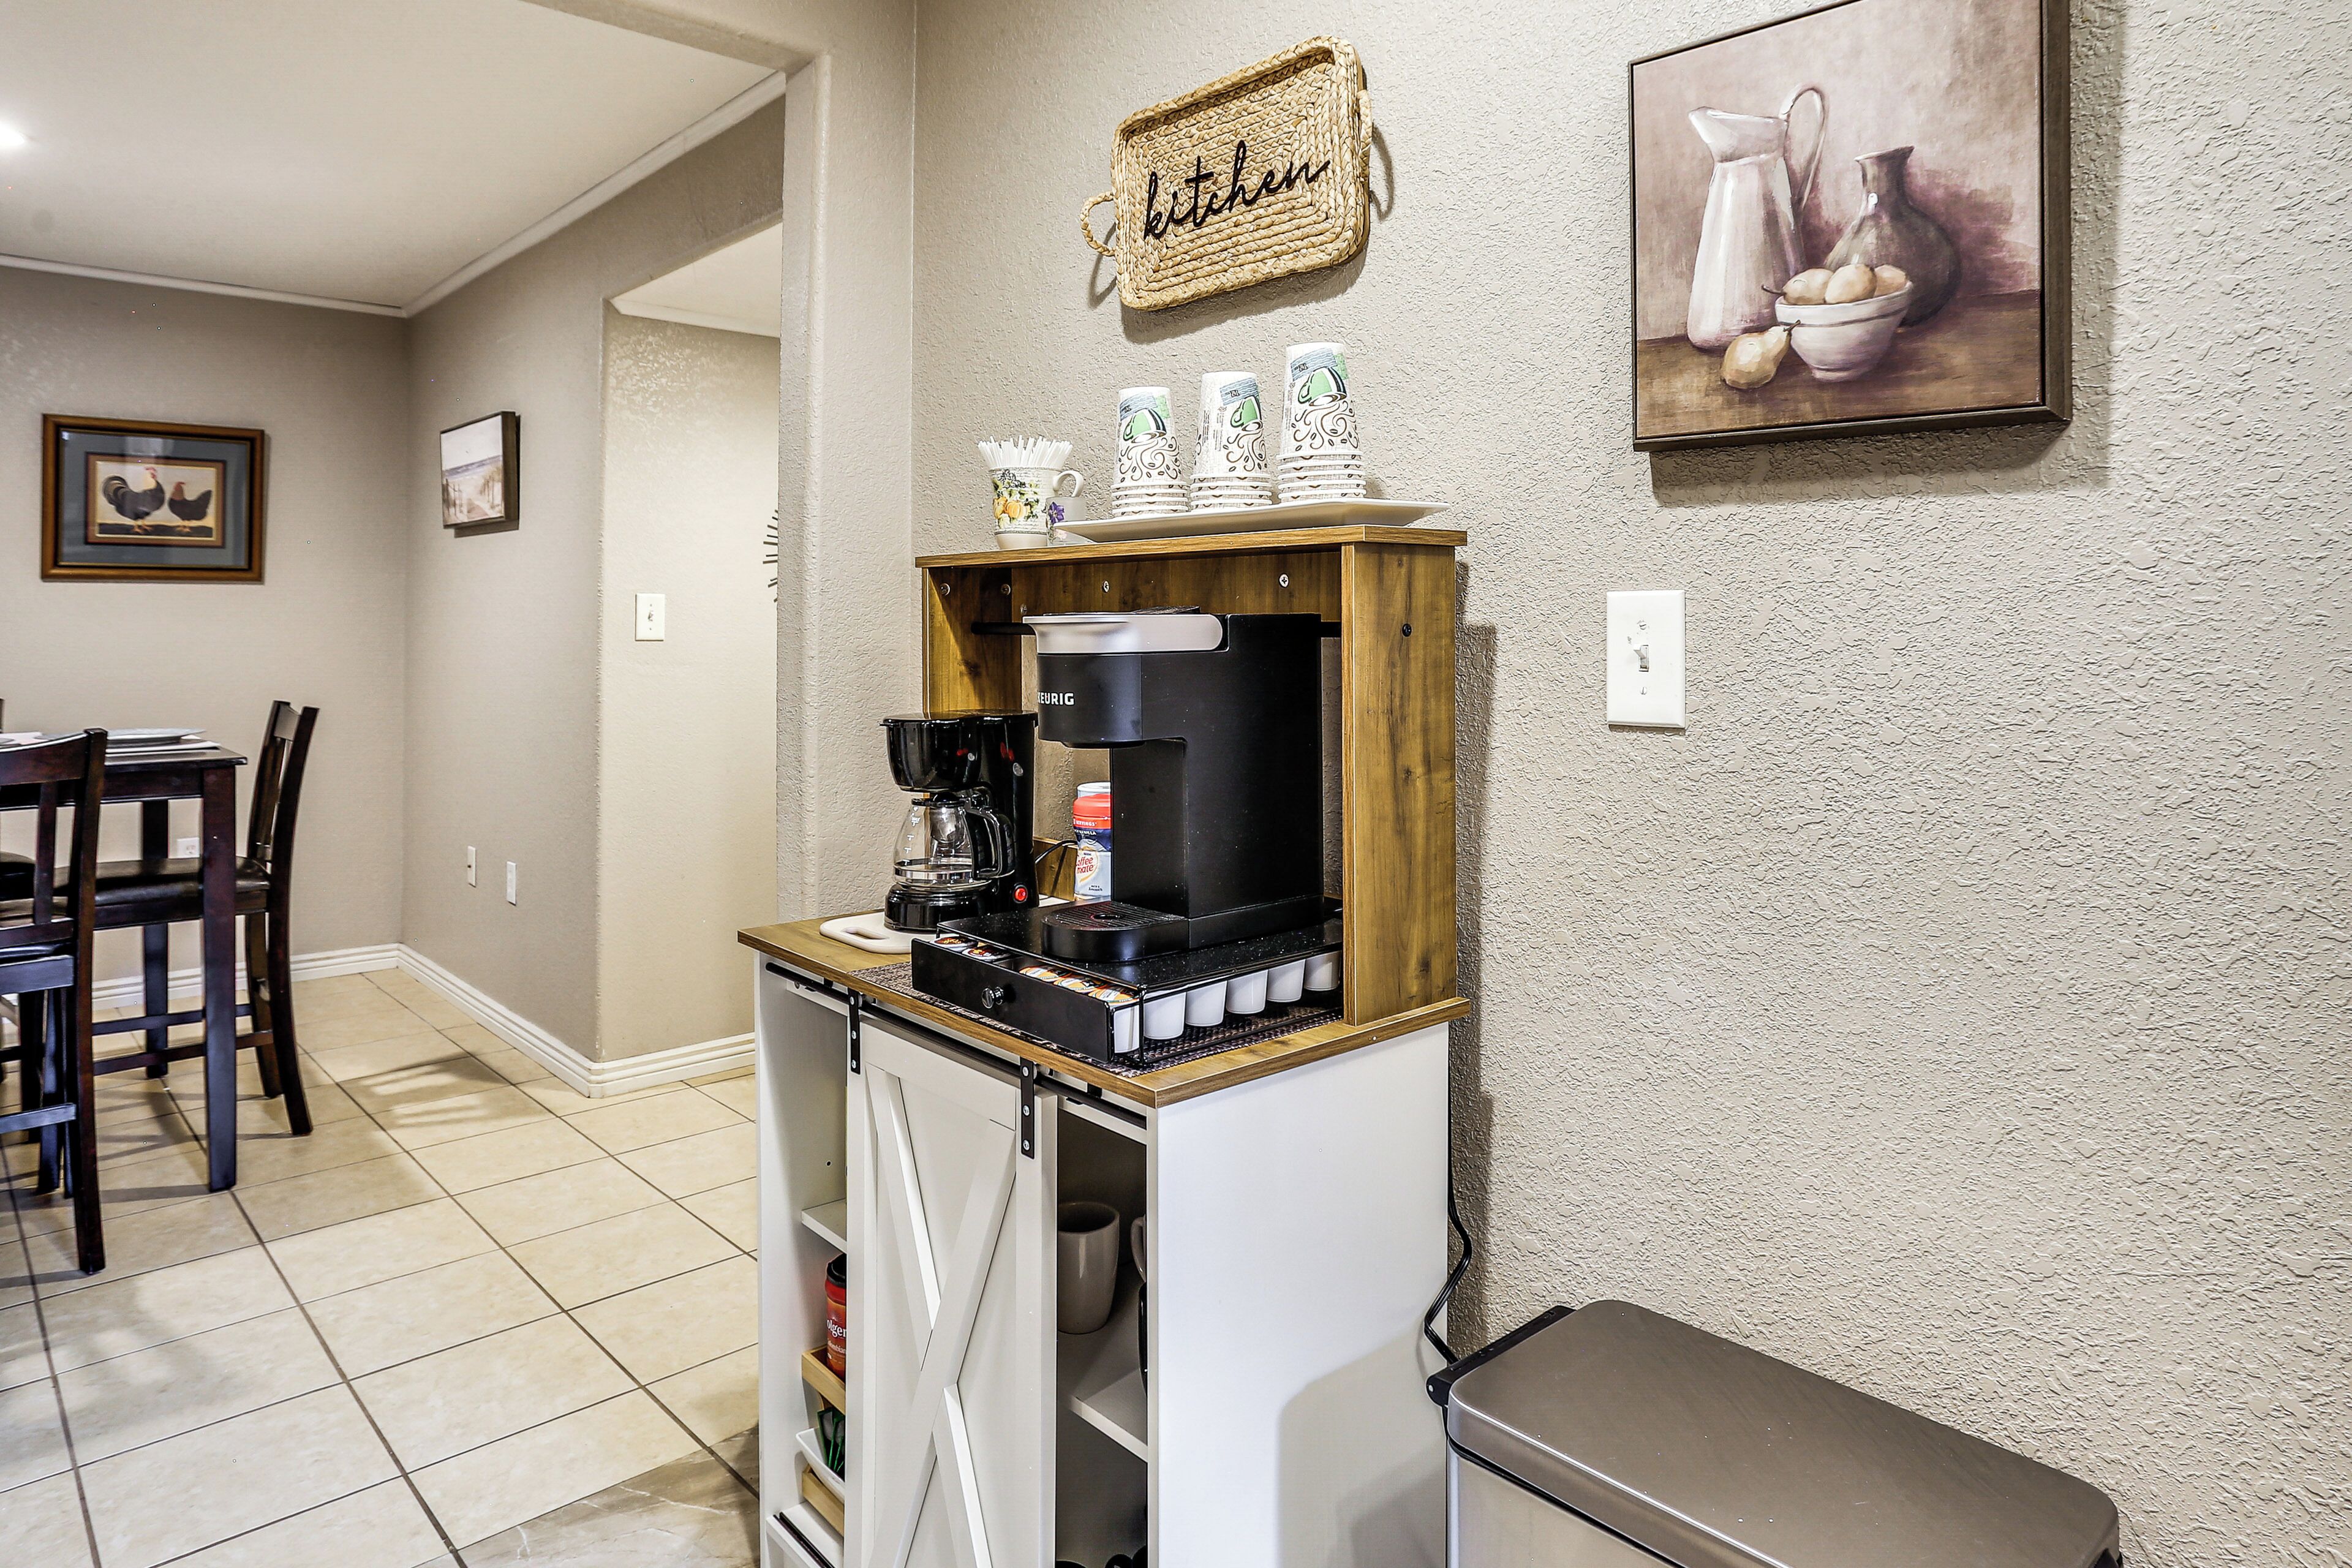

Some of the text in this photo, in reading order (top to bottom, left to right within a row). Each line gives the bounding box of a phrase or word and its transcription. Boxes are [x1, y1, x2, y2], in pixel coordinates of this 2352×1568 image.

[1144, 140, 1331, 240] kitchen
[1076, 854, 1093, 866] offee
[1077, 864, 1094, 874] mate
